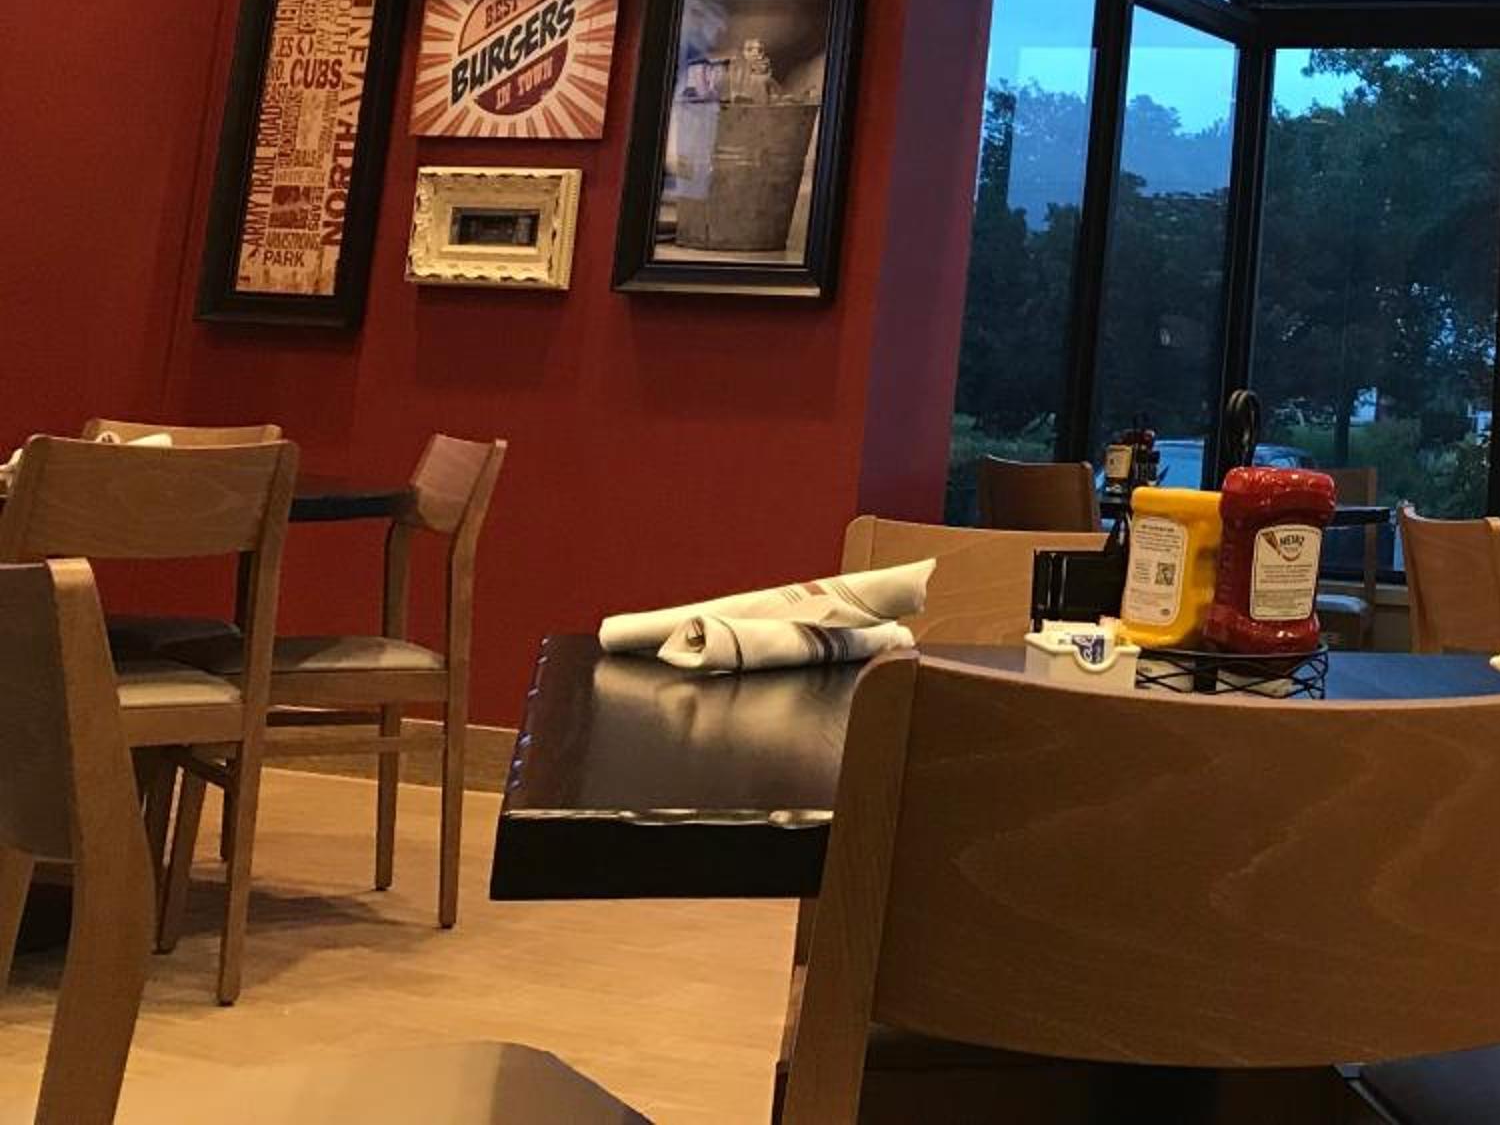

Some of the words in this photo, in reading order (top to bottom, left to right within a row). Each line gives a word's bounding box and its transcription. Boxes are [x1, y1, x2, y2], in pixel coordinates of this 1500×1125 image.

[289, 58, 343, 90] CUBS
[495, 83, 512, 110] IN
[517, 56, 553, 95] TOWN
[251, 153, 278, 195] TRAIL
[320, 118, 357, 247] NORTH
[243, 196, 271, 249] ARMY
[262, 249, 306, 268] PARK
